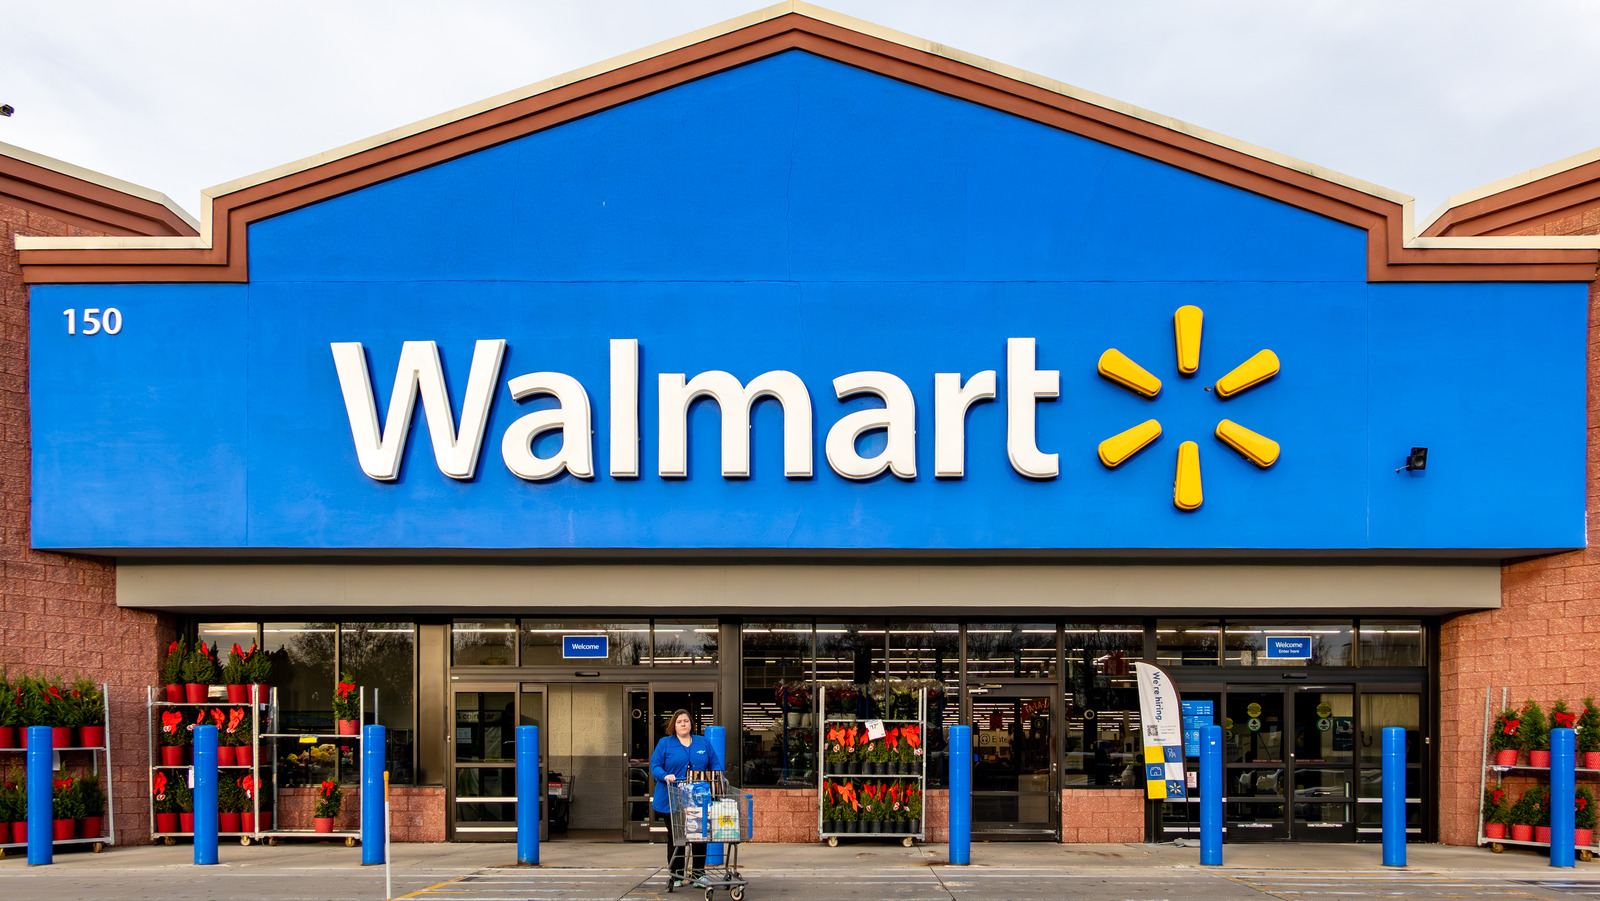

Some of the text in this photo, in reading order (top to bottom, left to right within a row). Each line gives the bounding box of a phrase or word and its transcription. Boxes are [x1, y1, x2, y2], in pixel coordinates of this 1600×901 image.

[63, 307, 123, 336] 150
[330, 336, 1061, 480] Walmart
[1152, 671, 1164, 723] We're hiring.
